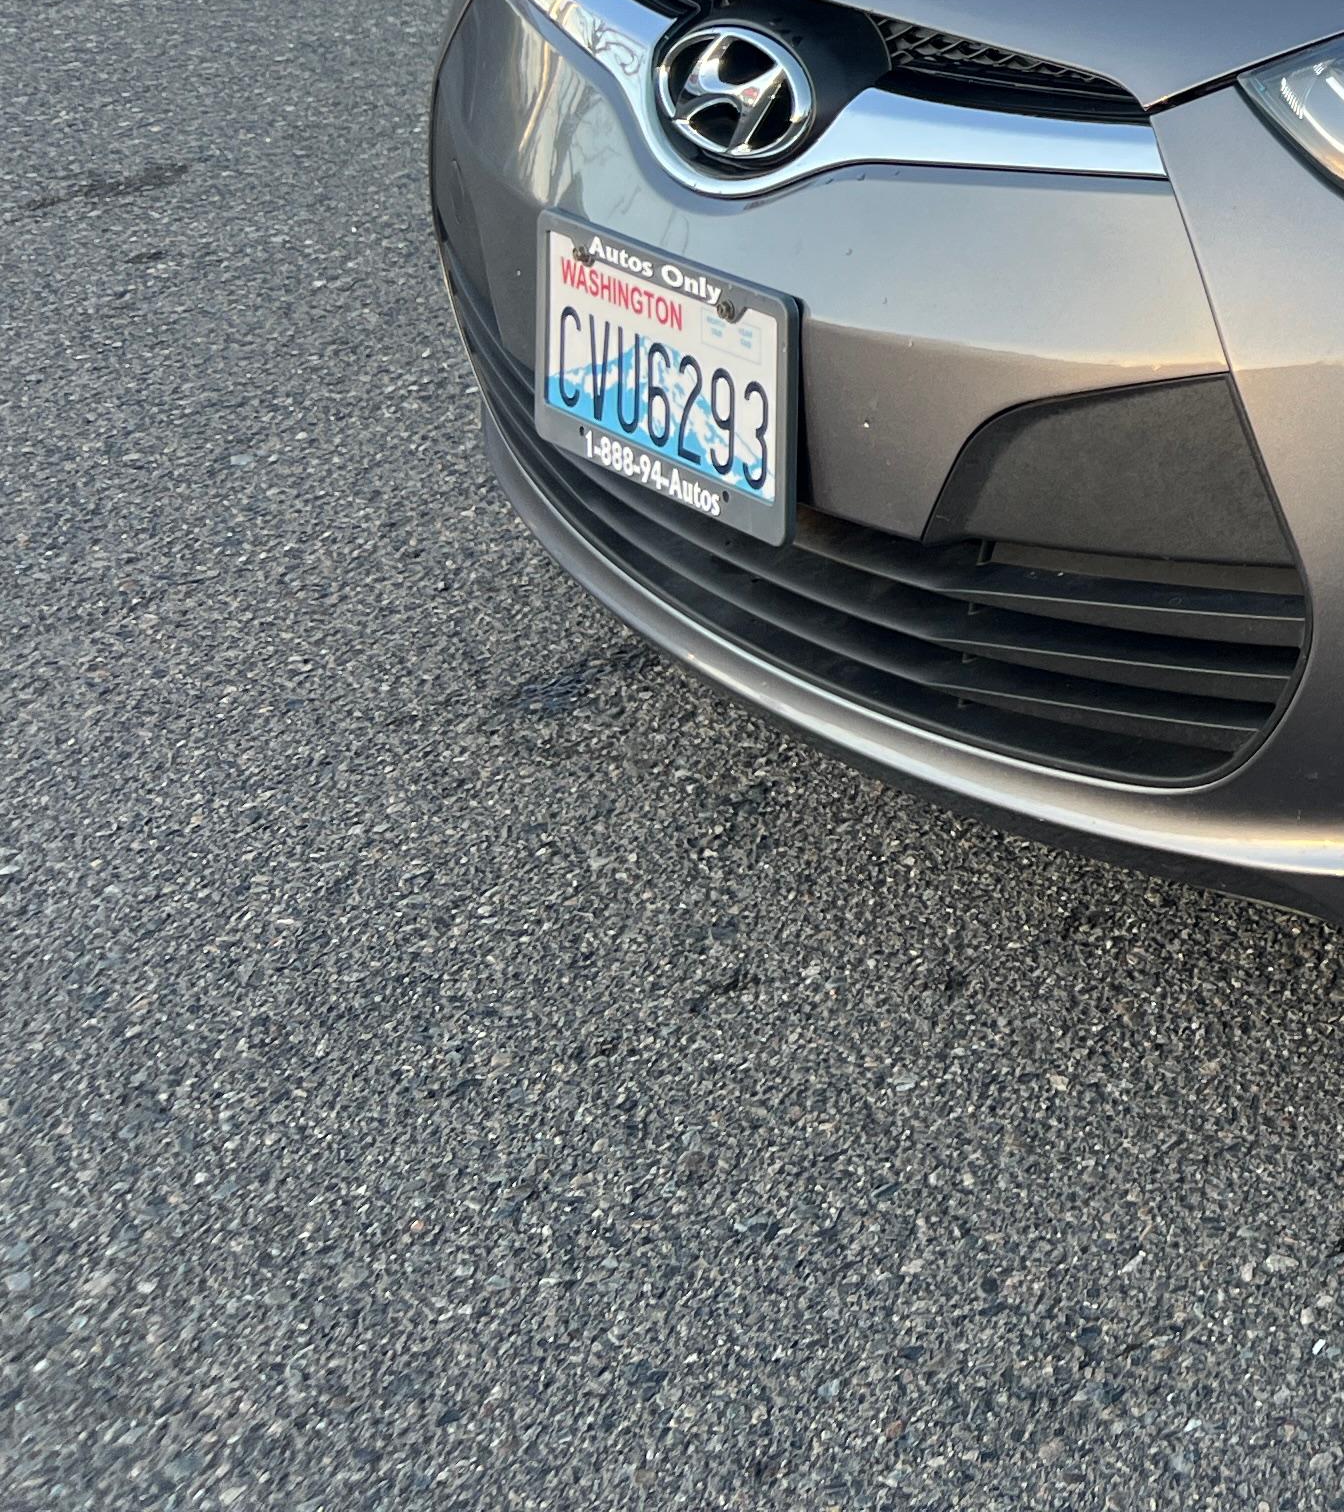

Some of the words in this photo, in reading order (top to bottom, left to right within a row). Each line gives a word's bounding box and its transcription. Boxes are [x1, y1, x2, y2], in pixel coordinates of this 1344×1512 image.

[561, 256, 683, 332] WASHINGTON
[588, 235, 654, 278] Autos
[660, 264, 722, 305] Only
[559, 305, 769, 490] CVU6293
[585, 430, 721, 517] 1-888-94-Autos
